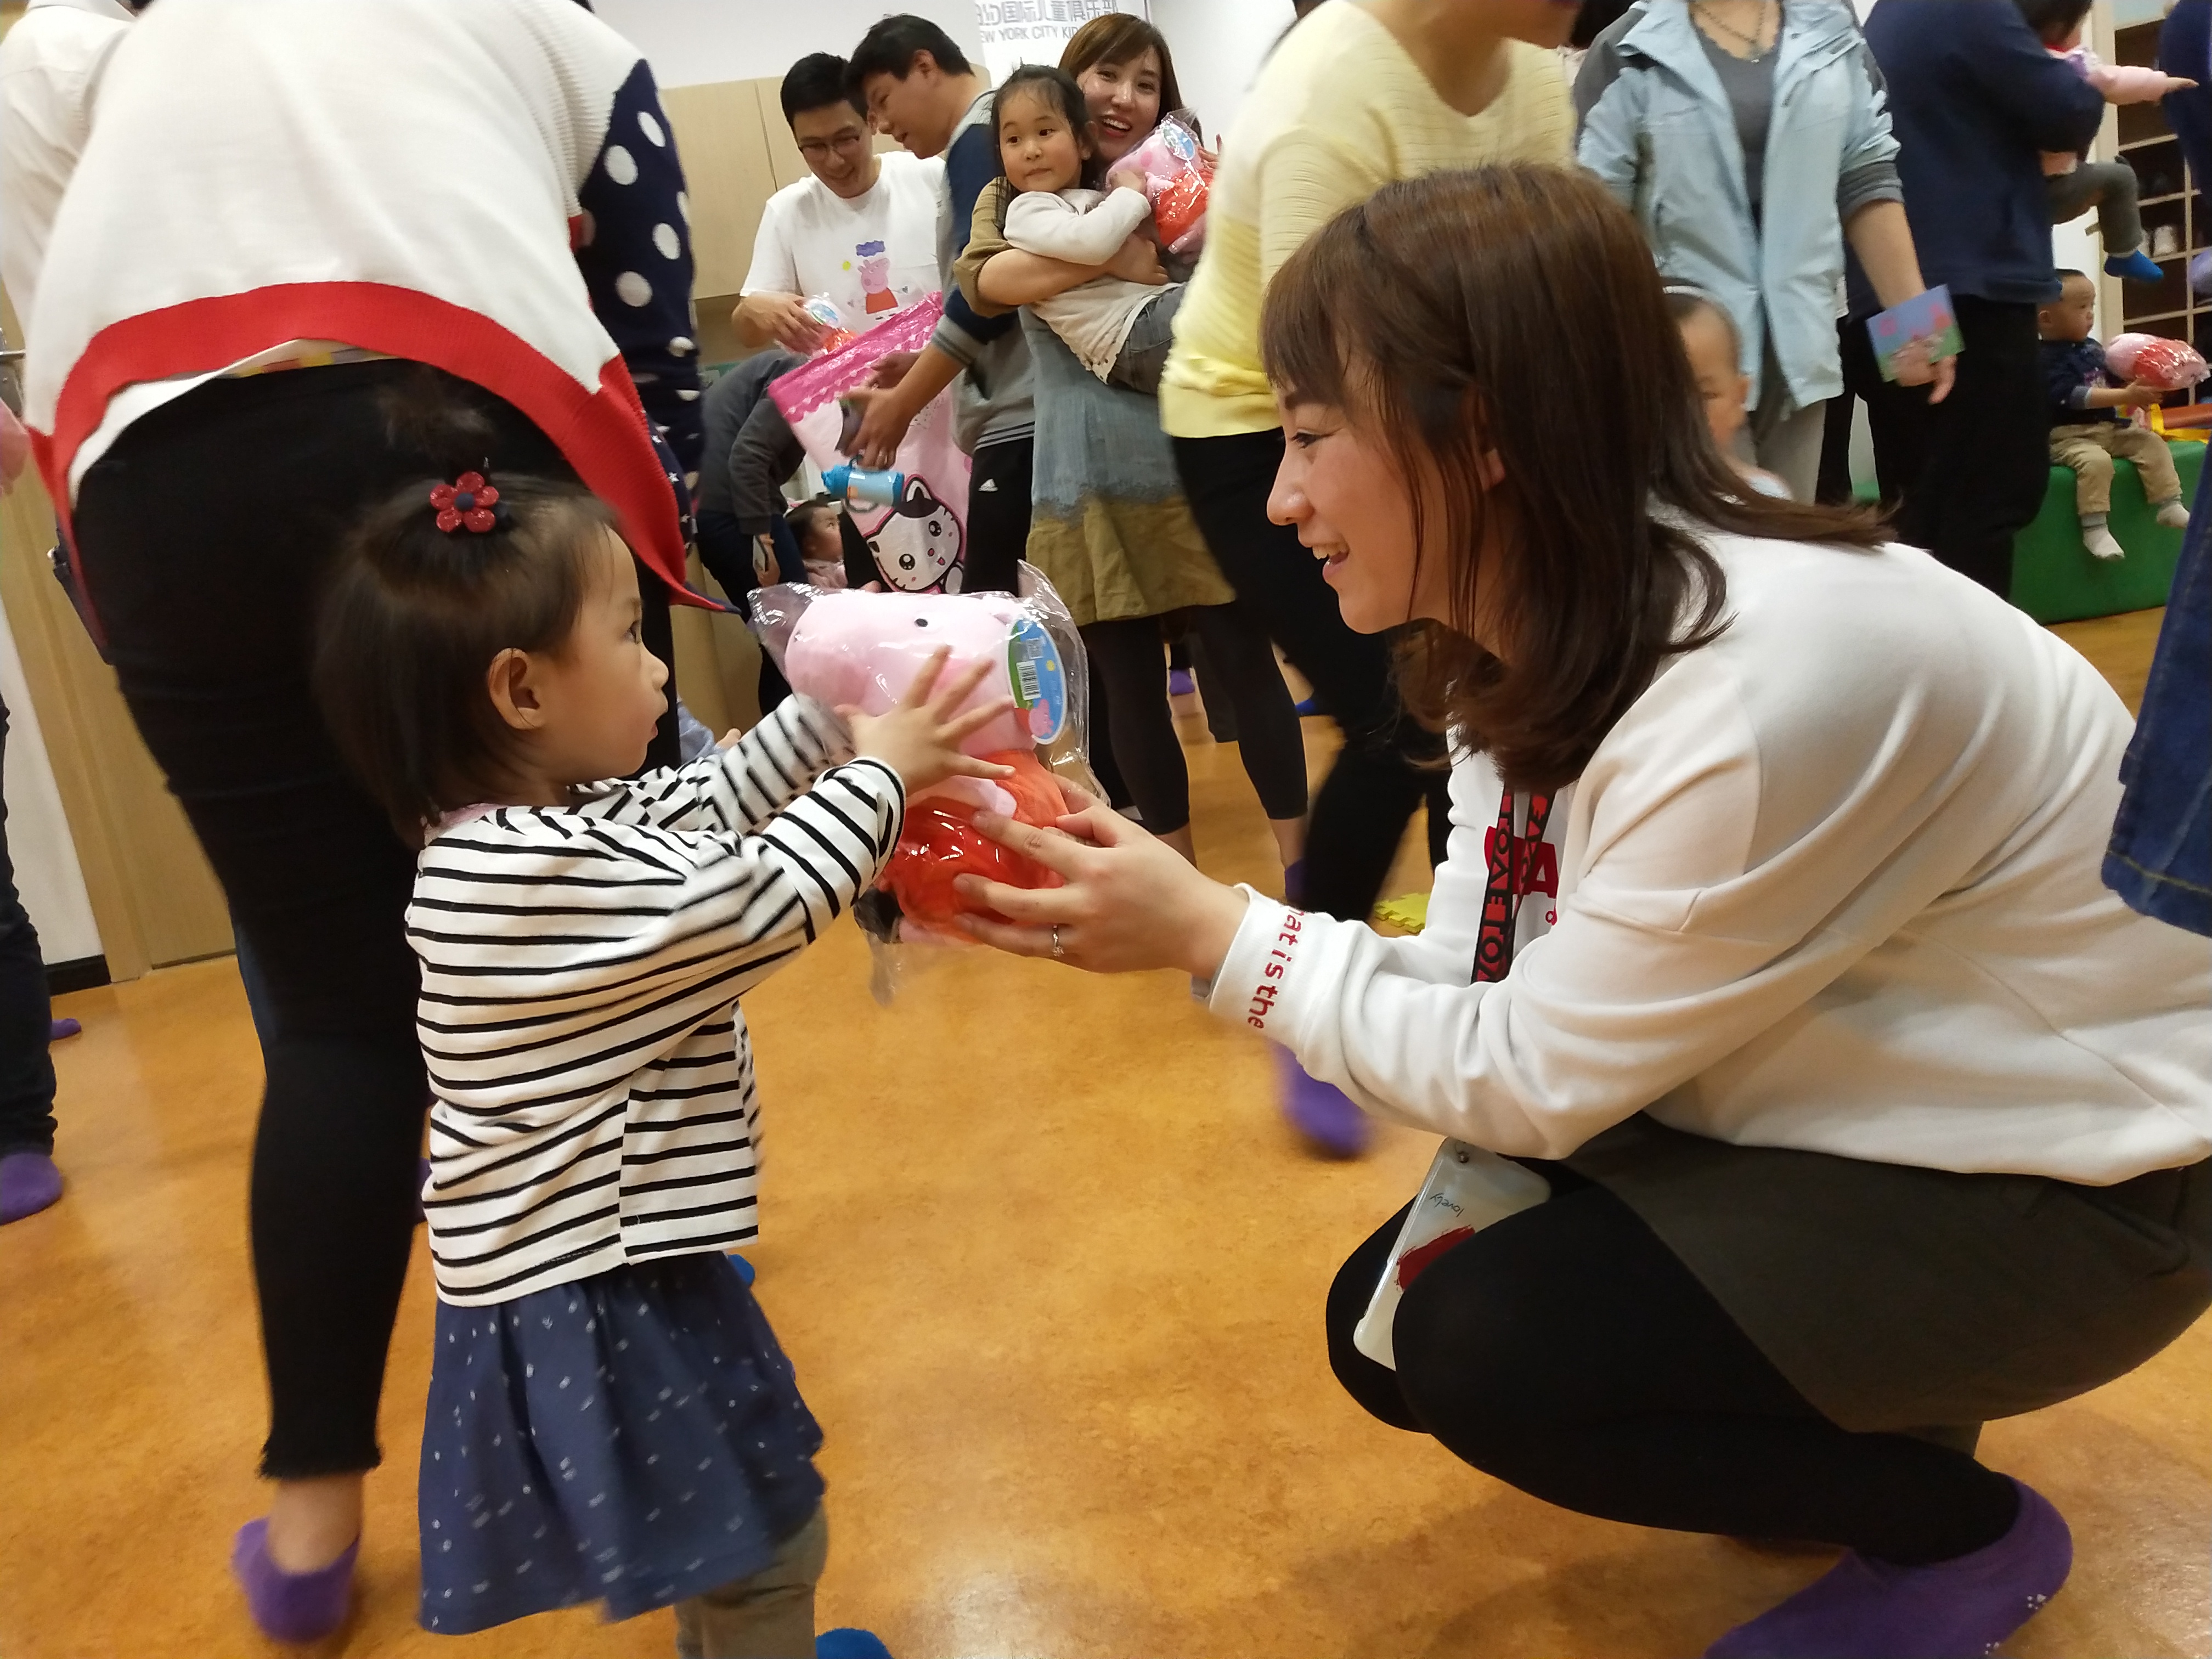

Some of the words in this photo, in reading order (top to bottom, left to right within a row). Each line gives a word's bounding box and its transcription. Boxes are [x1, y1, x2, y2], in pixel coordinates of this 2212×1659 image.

[998, 26, 1030, 41] YORK
[1031, 25, 1058, 39] CITY
[1062, 26, 1078, 38] KID
[1265, 949, 1292, 979] is
[1248, 985, 1278, 1029] the
[1429, 1193, 1465, 1217] lovely
